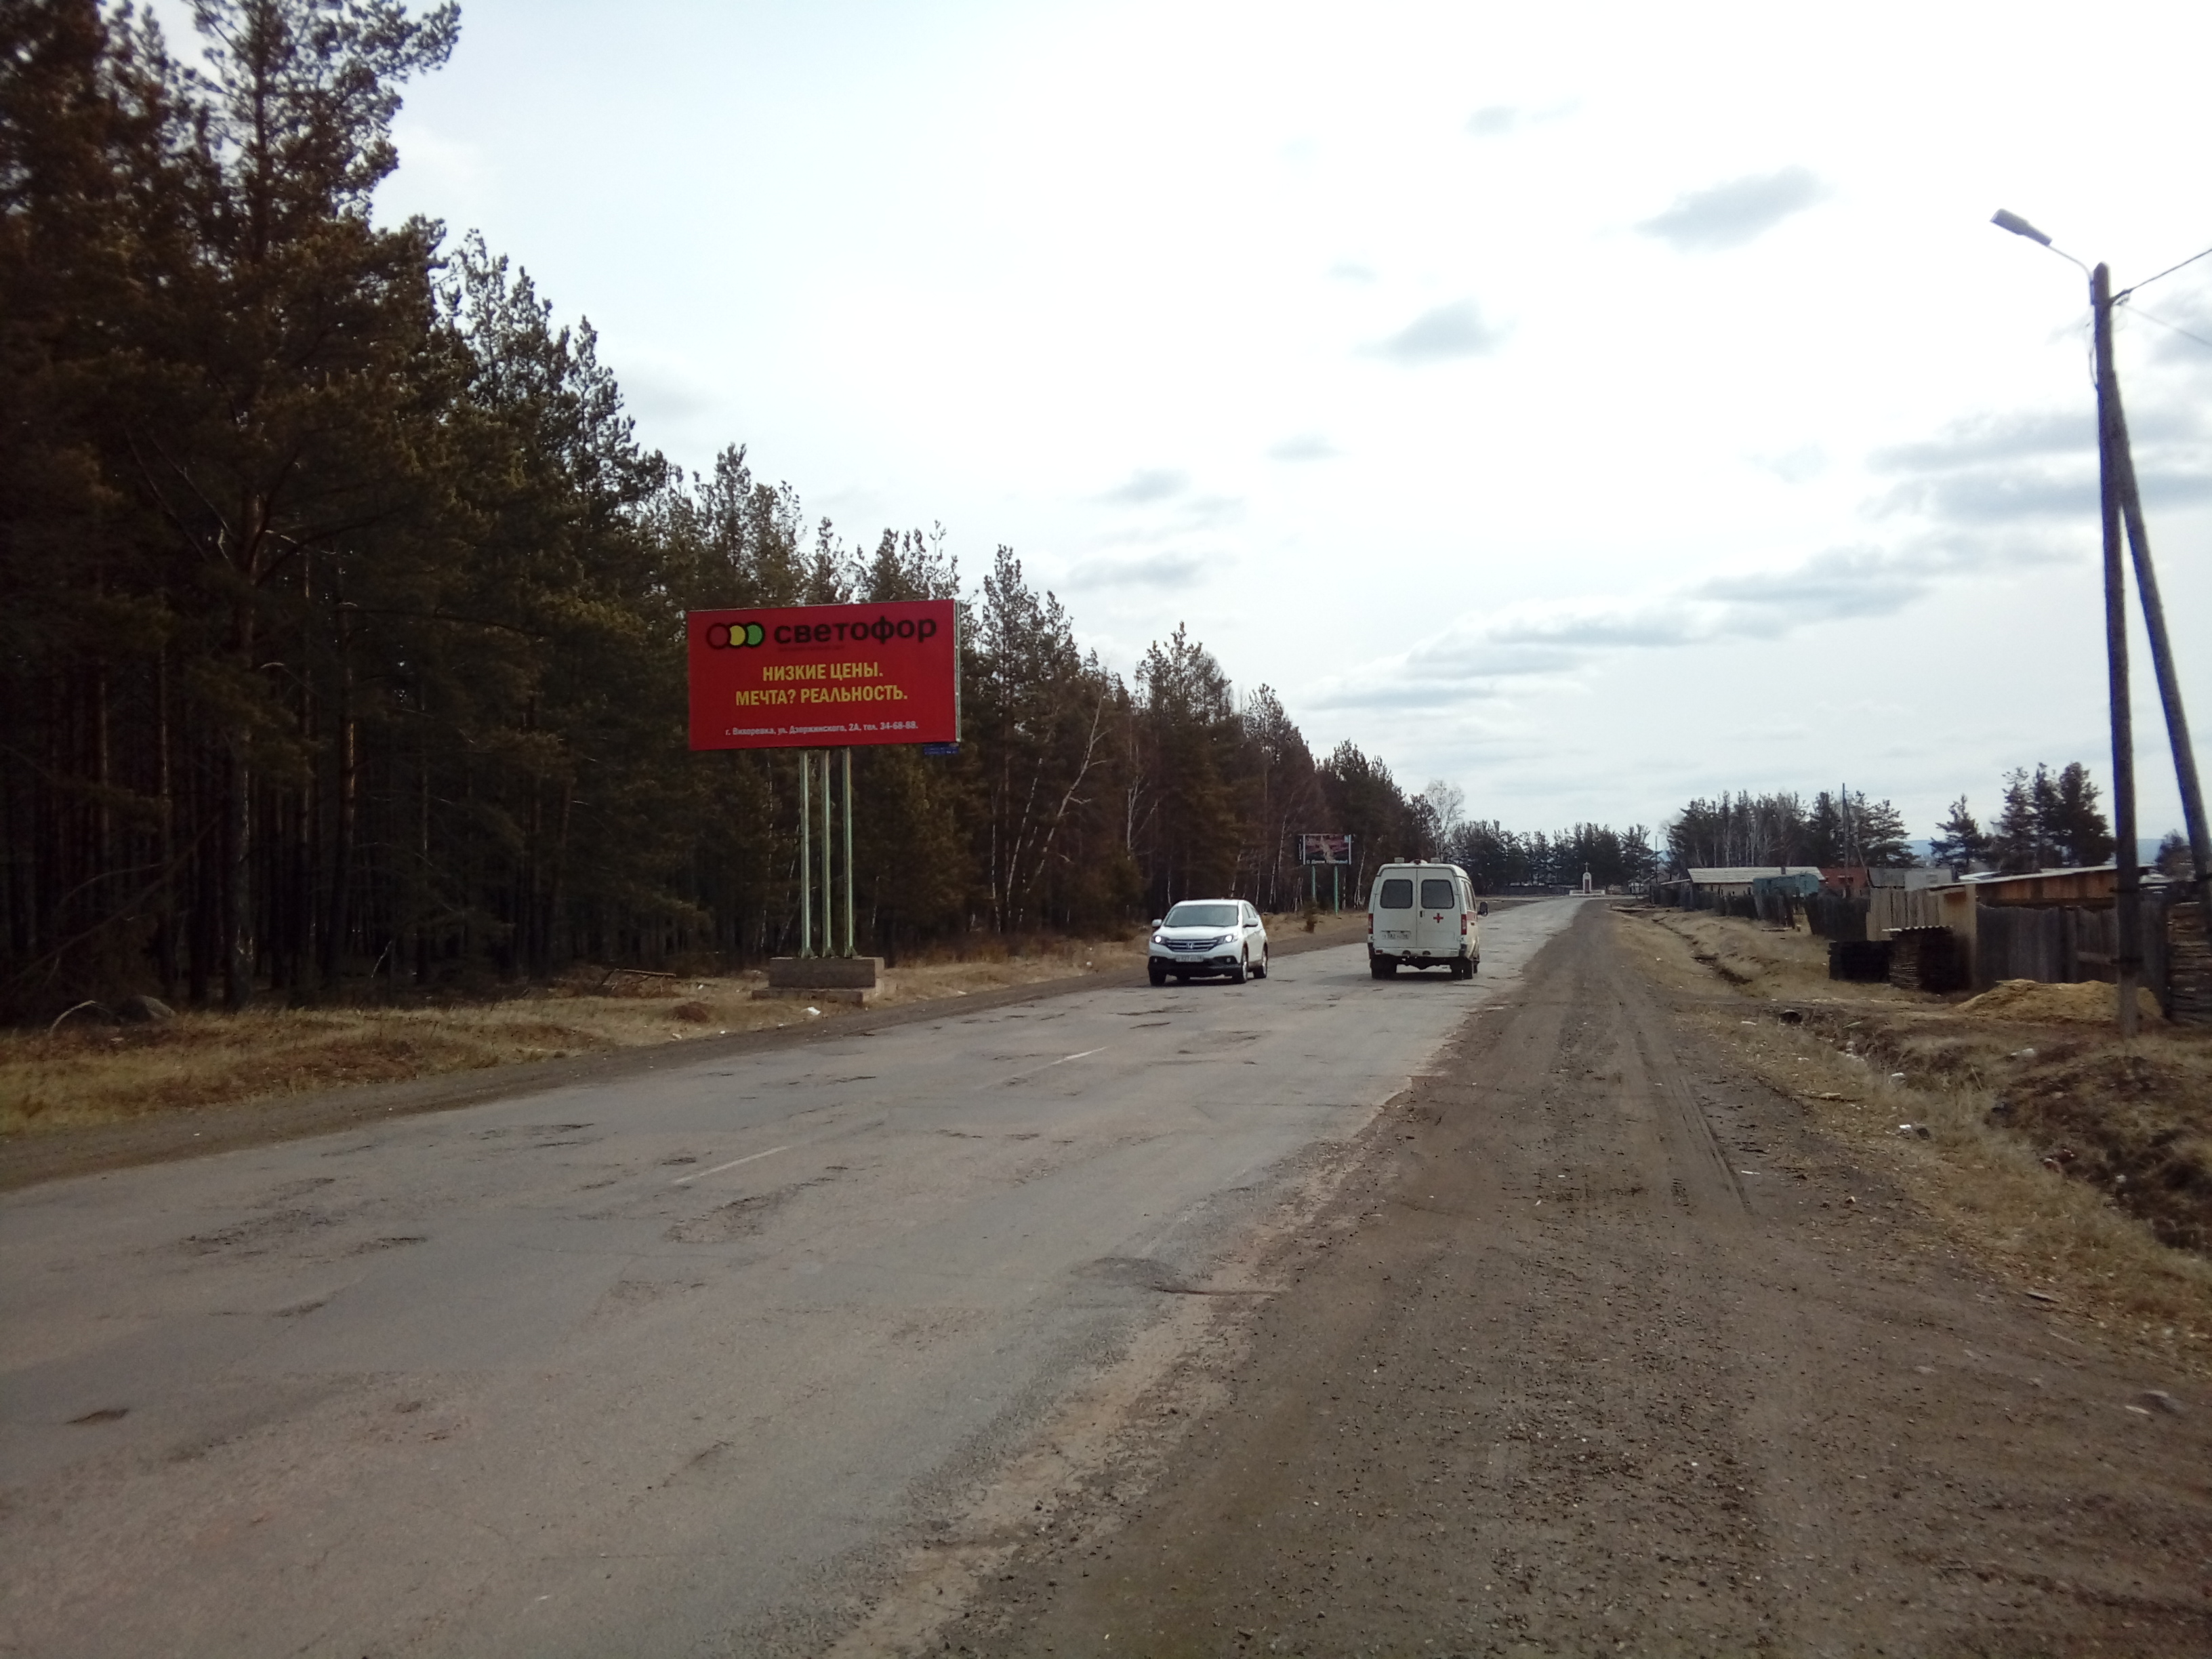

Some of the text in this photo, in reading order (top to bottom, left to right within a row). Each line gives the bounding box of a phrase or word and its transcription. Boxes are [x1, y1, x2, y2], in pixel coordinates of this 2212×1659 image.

[774, 615, 937, 644] светофор
[763, 661, 884, 681] НИЗКИЕ ЦЕНЫ.
[736, 684, 908, 706] МЕЧТА? РЕАЛЬНОСТЬ.
